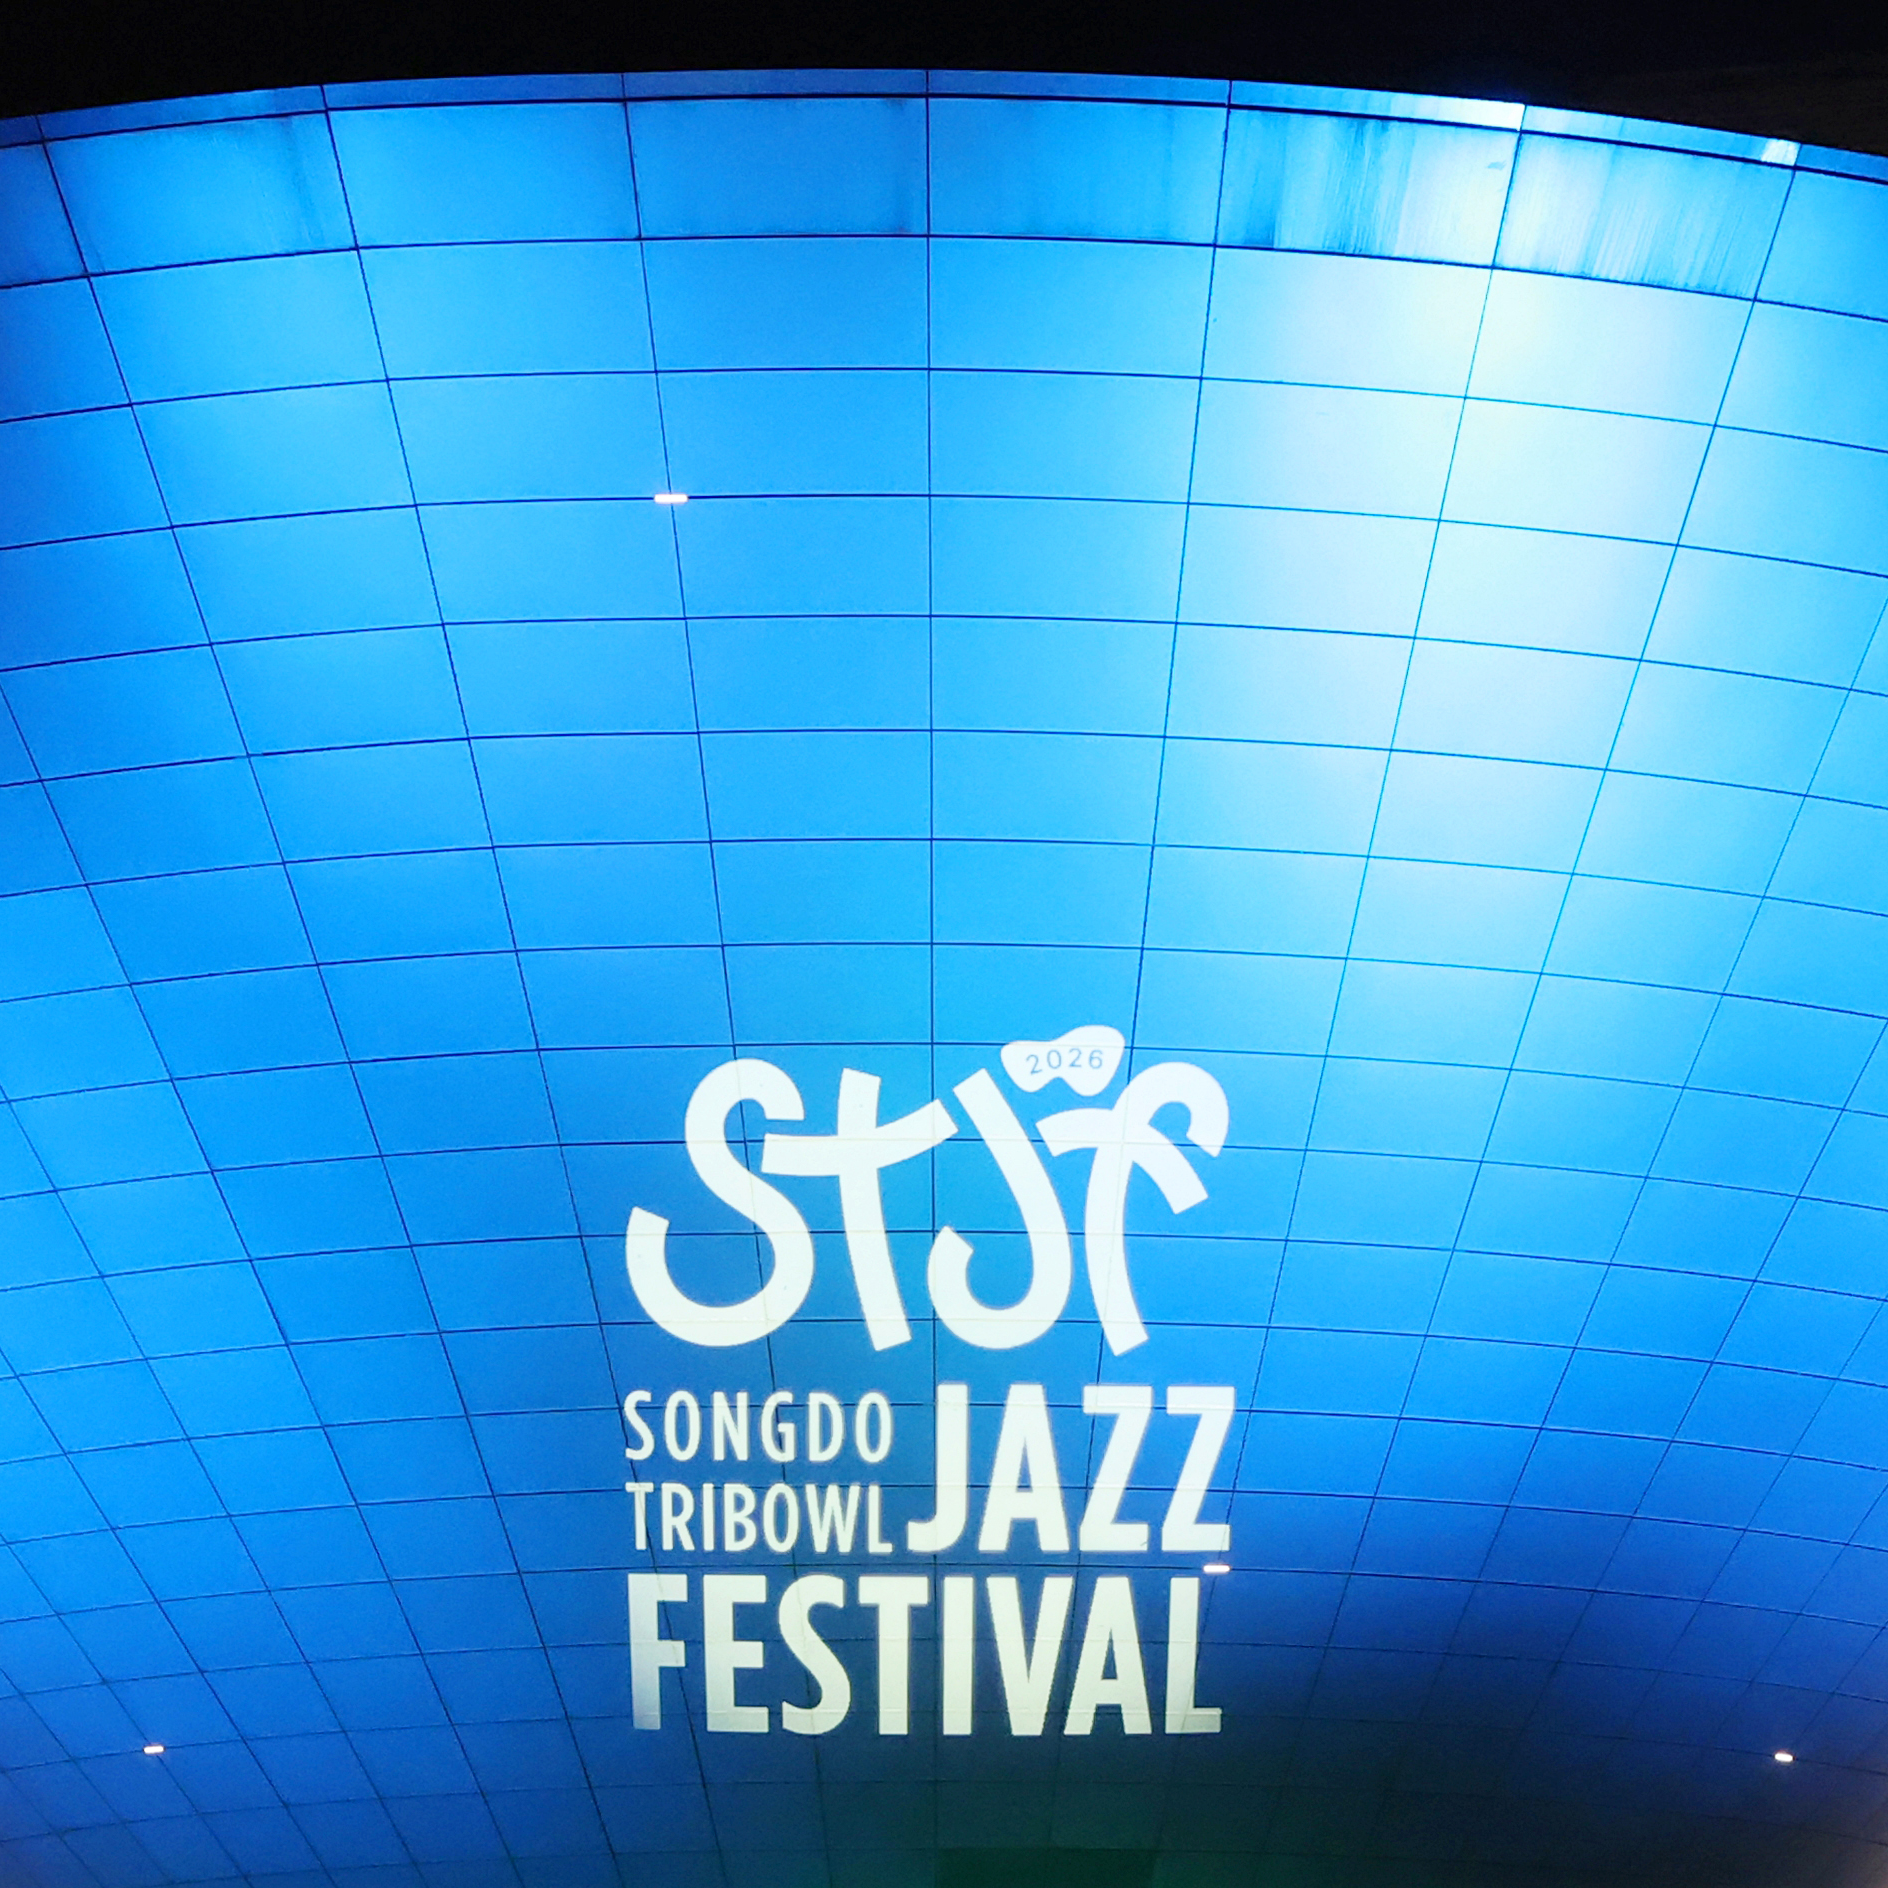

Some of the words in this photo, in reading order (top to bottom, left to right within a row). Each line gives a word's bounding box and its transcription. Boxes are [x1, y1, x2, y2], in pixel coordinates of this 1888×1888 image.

[1025, 1047, 1104, 1076] 2026
[624, 1390, 892, 1463] SONGDO
[907, 1383, 1236, 1552] JAZZ
[625, 1482, 893, 1554] TRIBOWL
[627, 1573, 1222, 1736] FESTIVAL
